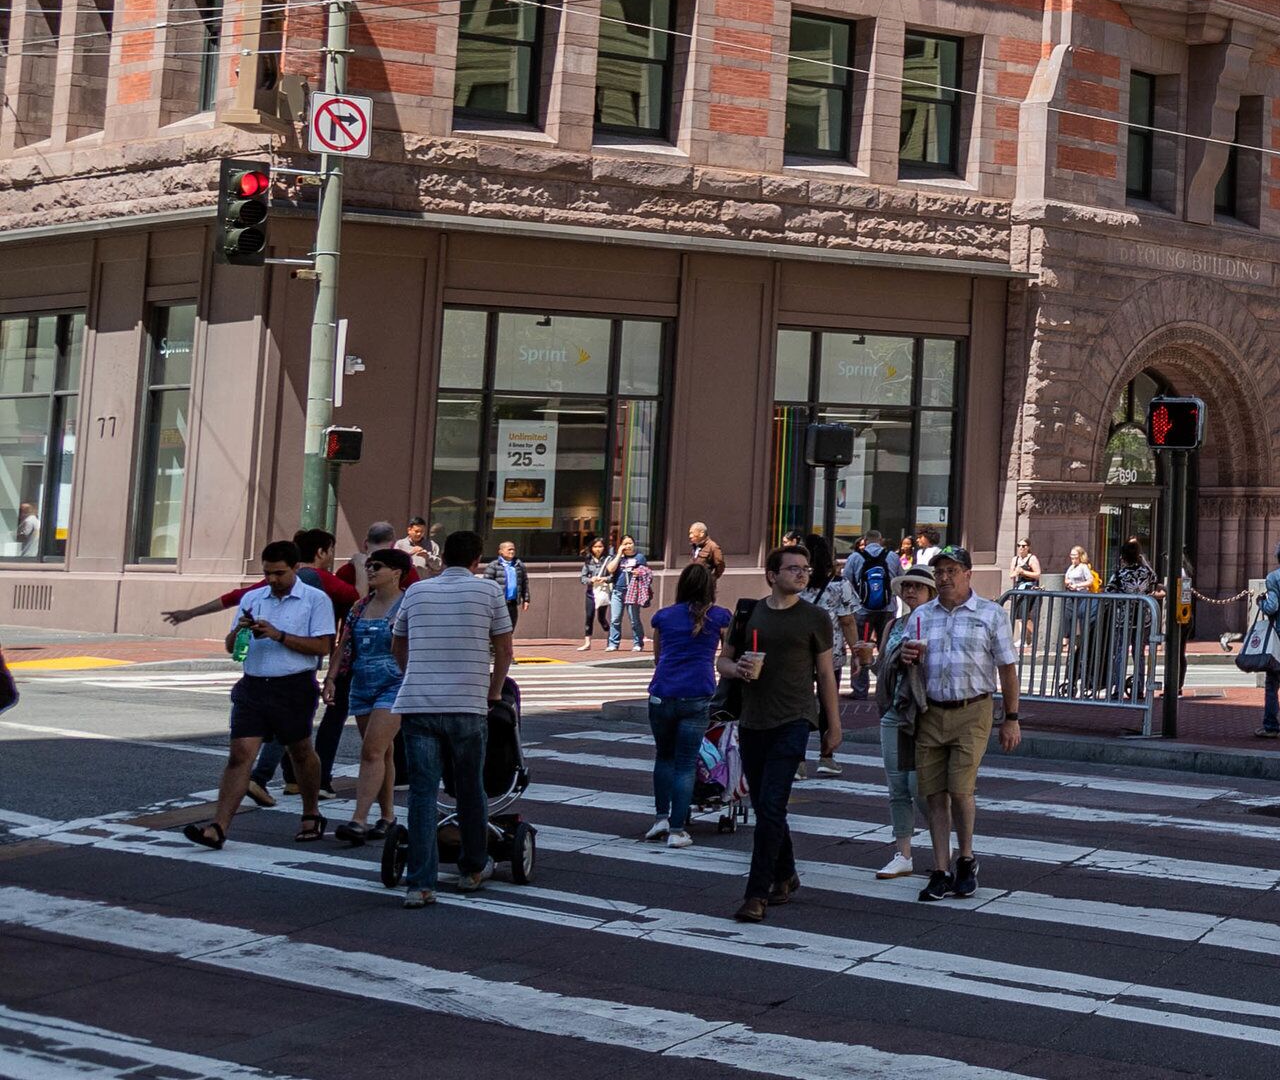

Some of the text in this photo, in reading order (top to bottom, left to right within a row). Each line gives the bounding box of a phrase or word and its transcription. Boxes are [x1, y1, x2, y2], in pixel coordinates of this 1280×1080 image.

[1192, 253, 1260, 281] BUILDING
[160, 337, 190, 358] Sprint
[519, 344, 568, 365] Sprint
[838, 360, 879, 377] Sprint
[509, 432, 548, 441] Unlimited
[507, 451, 534, 467] $25
[1119, 470, 1137, 482] 690
